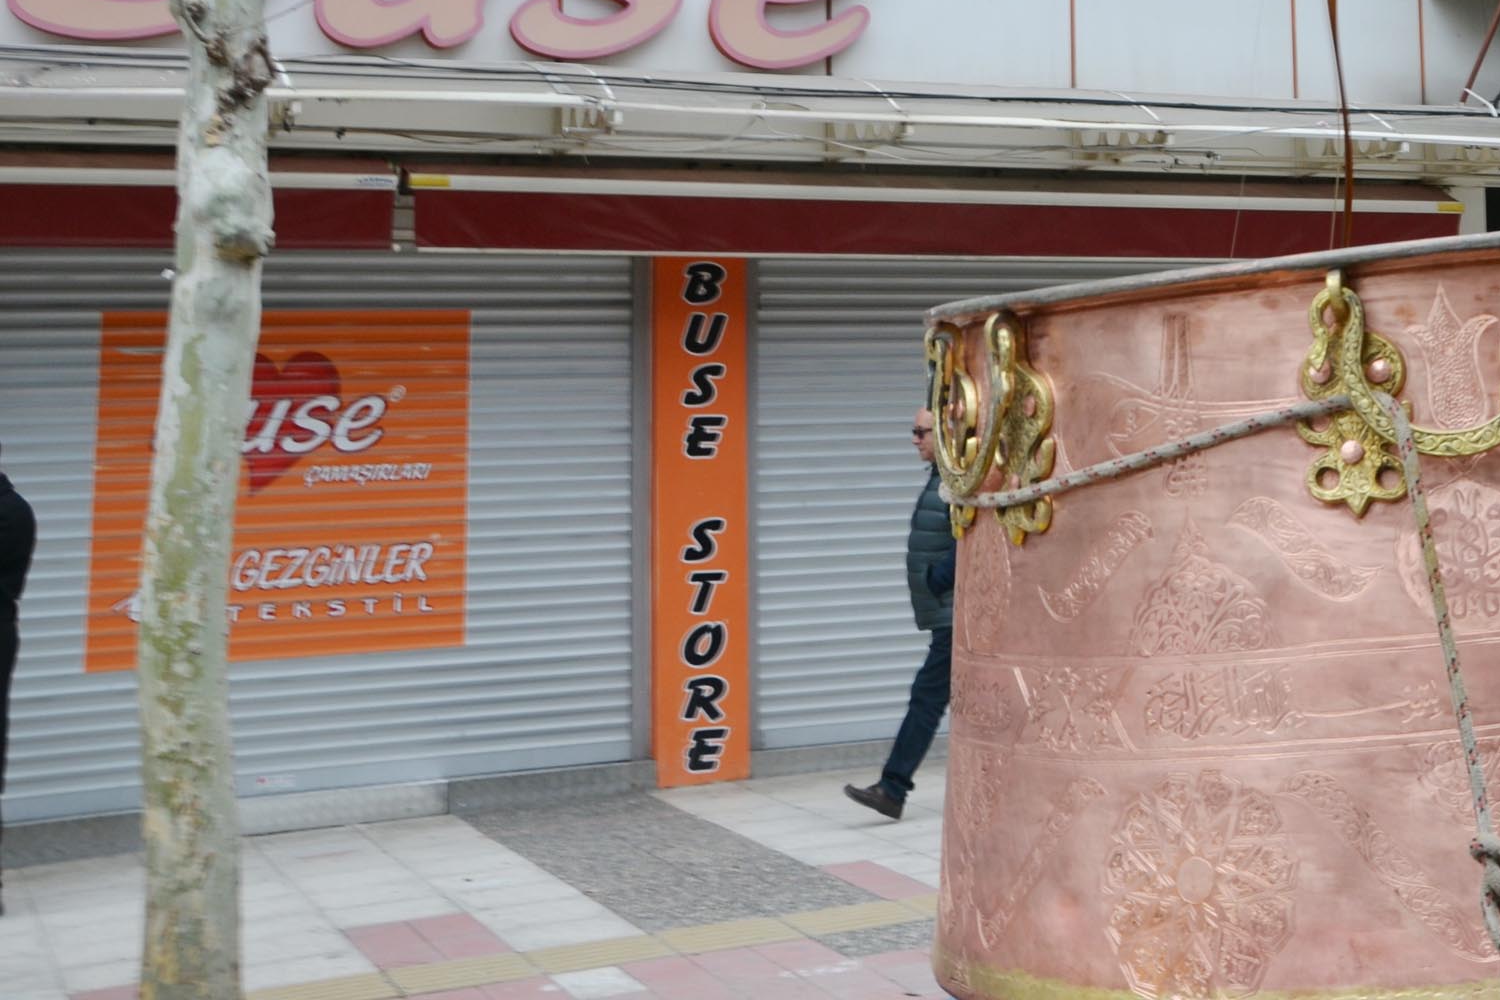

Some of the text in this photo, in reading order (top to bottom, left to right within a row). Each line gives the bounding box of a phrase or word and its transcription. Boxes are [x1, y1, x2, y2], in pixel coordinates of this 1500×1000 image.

[304, 463, 433, 487] ÇAMAŞIRLARI
[681, 262, 730, 775] BUSE STORE
